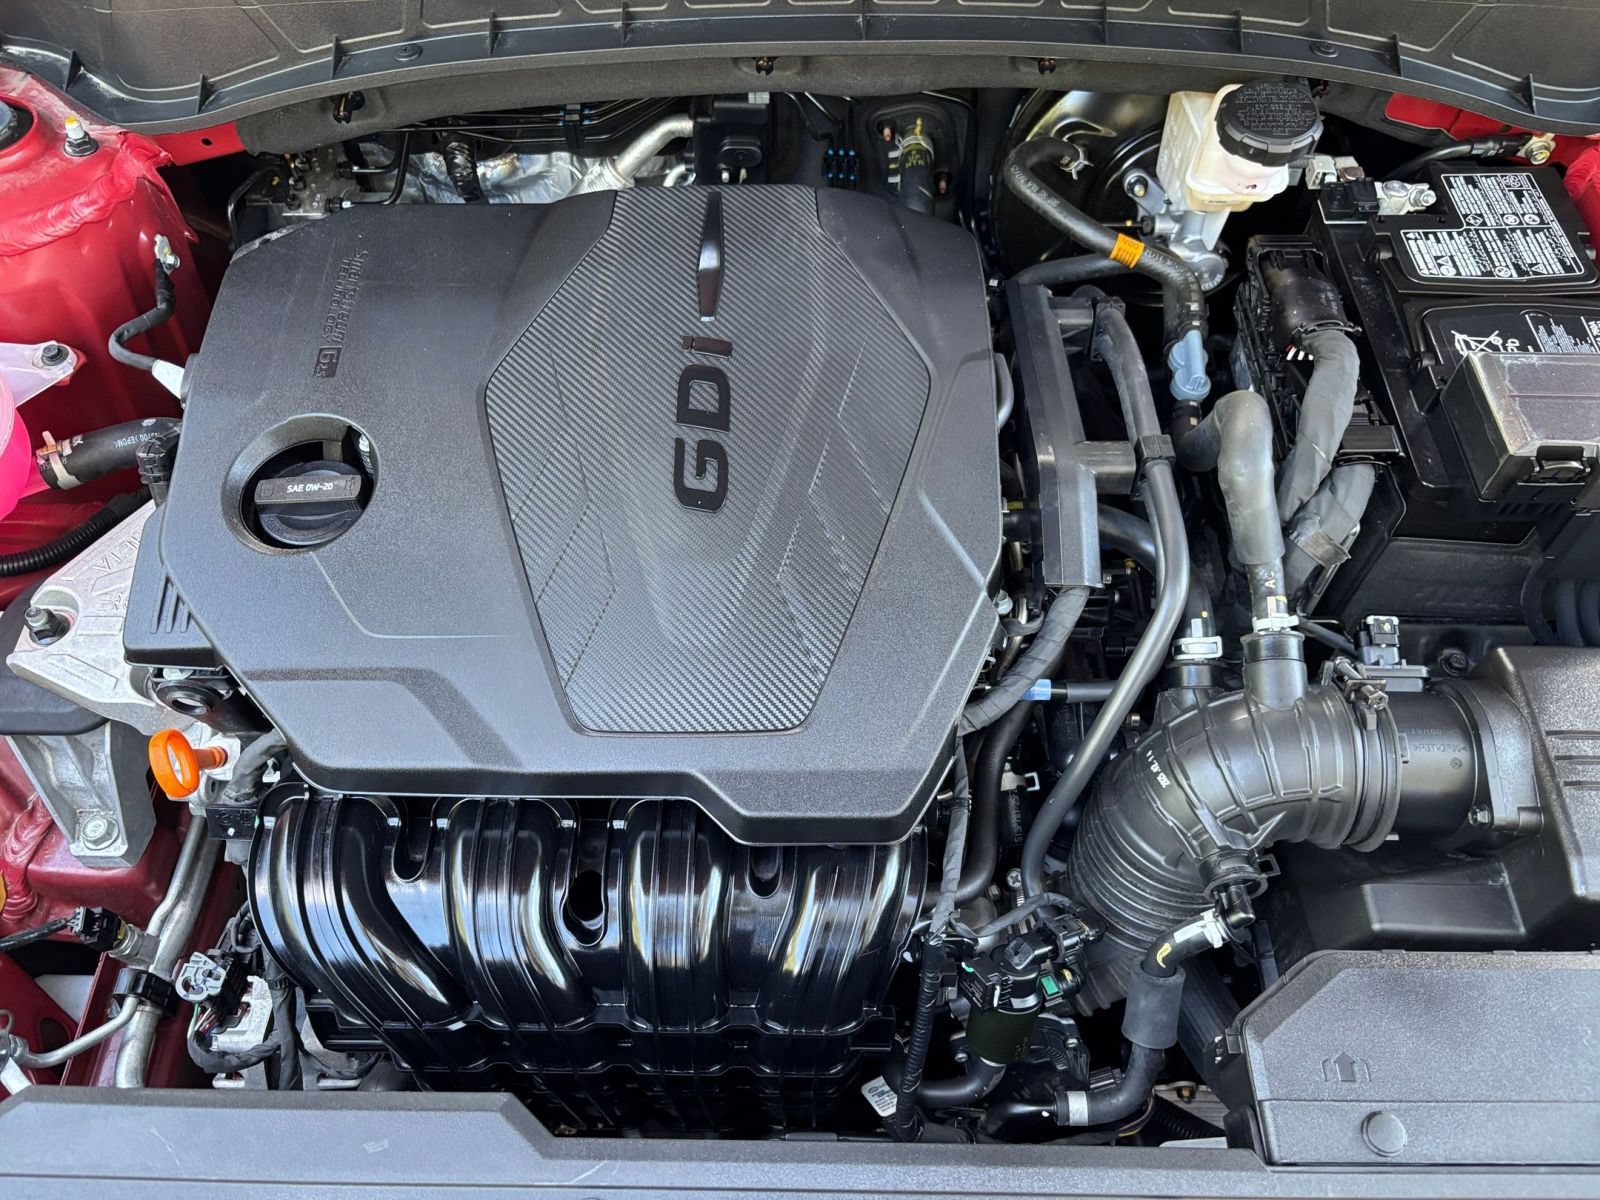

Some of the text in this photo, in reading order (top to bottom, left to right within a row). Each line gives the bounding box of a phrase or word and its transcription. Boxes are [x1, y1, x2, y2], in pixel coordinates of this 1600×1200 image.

[322, 257, 351, 343] TECHNOLOGY
[673, 335, 734, 514] GDi
[286, 482, 334, 494] SAE 0W-20
